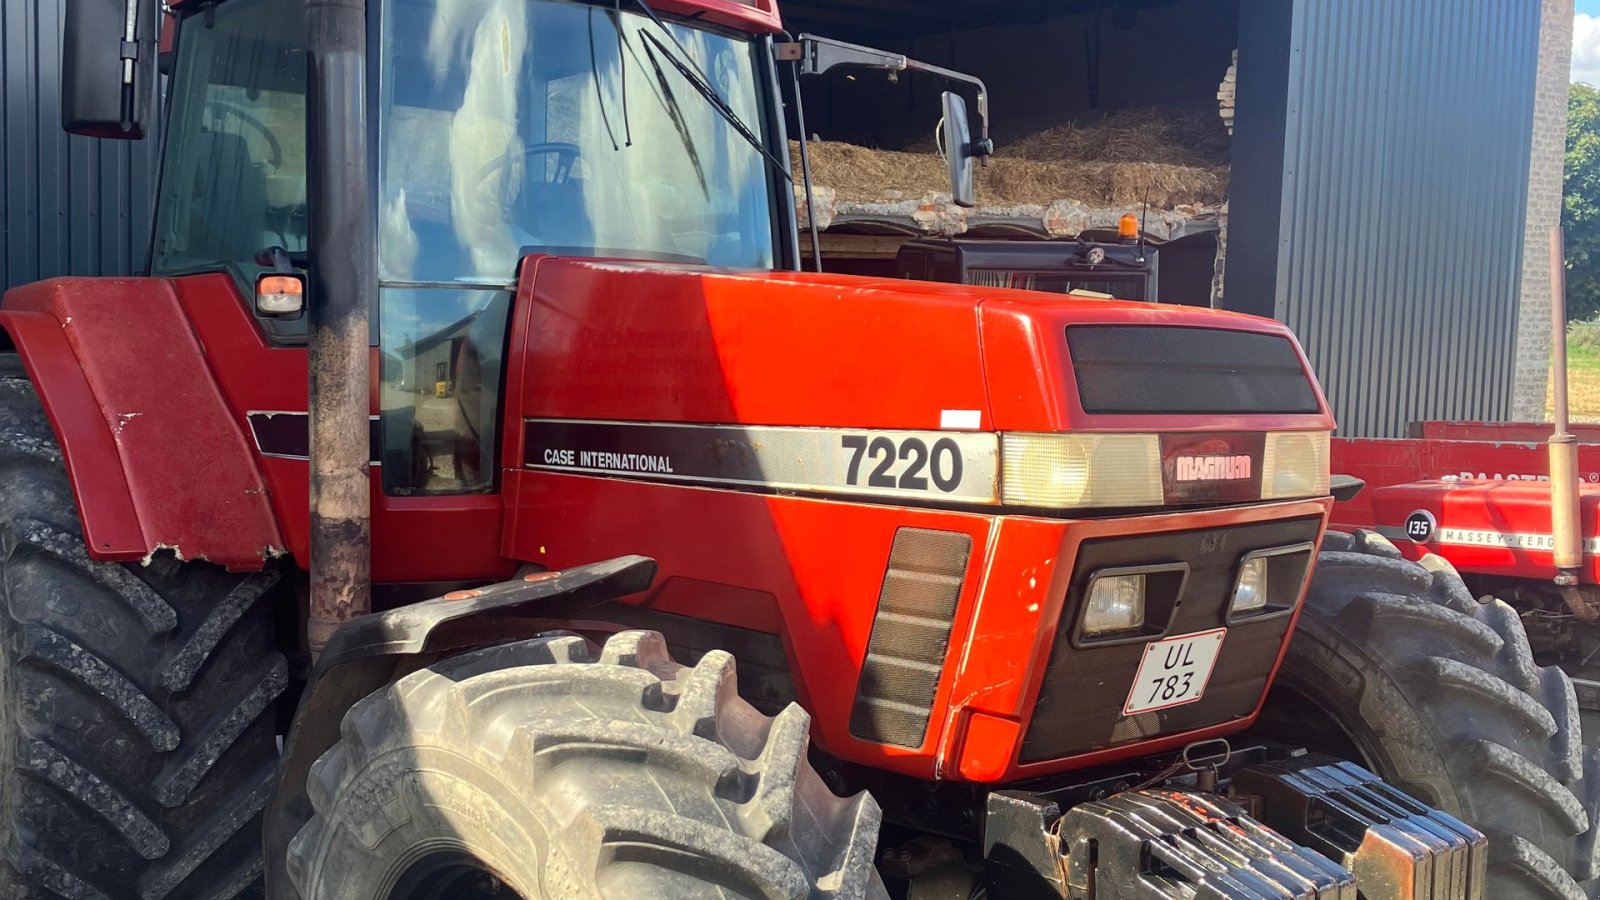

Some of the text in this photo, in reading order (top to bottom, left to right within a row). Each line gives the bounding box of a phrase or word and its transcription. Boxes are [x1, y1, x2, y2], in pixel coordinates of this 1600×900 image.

[544, 448, 674, 473] CASE INTERNATIONAL
[841, 434, 964, 493] 7220
[1176, 454, 1251, 481] MAGNUM
[1408, 520, 1429, 535] 135
[1445, 530, 1504, 544] MASSEY
[1164, 642, 1194, 670] UL
[1147, 671, 1195, 704] 783
